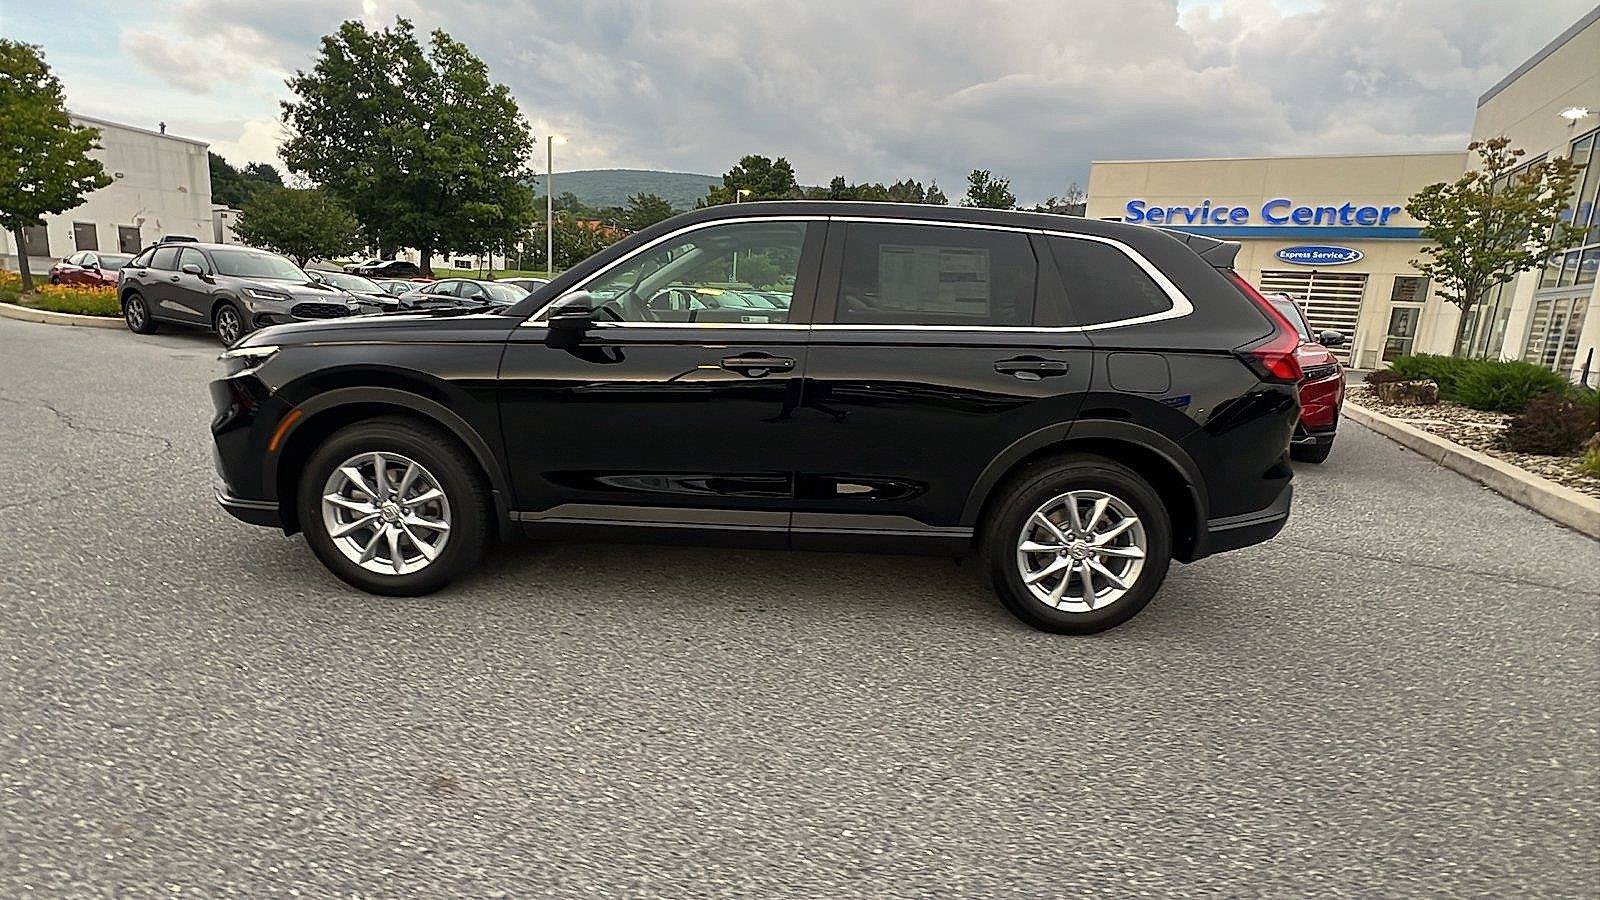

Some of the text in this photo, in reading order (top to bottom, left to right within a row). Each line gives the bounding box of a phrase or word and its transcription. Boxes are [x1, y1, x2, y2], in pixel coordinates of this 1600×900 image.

[1125, 199, 1401, 225] Service Center
[1280, 251, 1311, 259] Express
